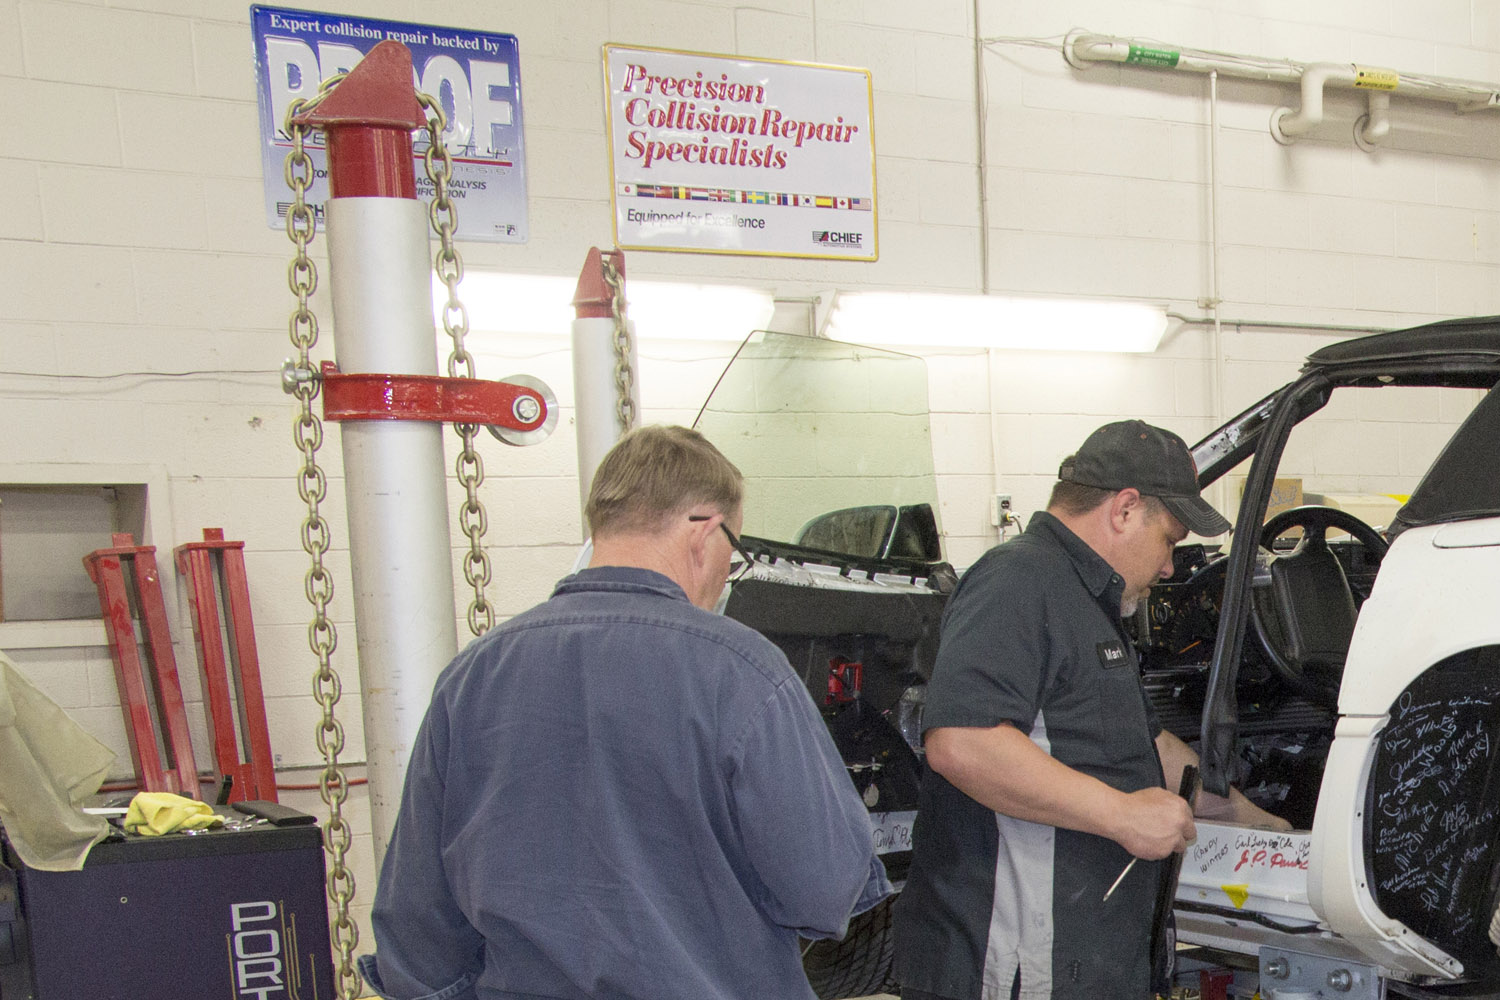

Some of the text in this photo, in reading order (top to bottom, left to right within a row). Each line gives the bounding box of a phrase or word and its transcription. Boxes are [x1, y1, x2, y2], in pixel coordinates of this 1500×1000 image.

[270, 14, 500, 54] Expert collision repair backed by
[621, 63, 764, 104] Precision
[625, 97, 858, 148] Collision Repair
[624, 130, 788, 169] Specialists
[448, 179, 488, 191] NALYSIS
[627, 208, 766, 229] Equipped for Excellence
[829, 232, 863, 244] CHIEF
[1104, 646, 1123, 660] Mark
[1193, 837, 1218, 861] RANDY
[1200, 844, 1229, 874] WINTERS
